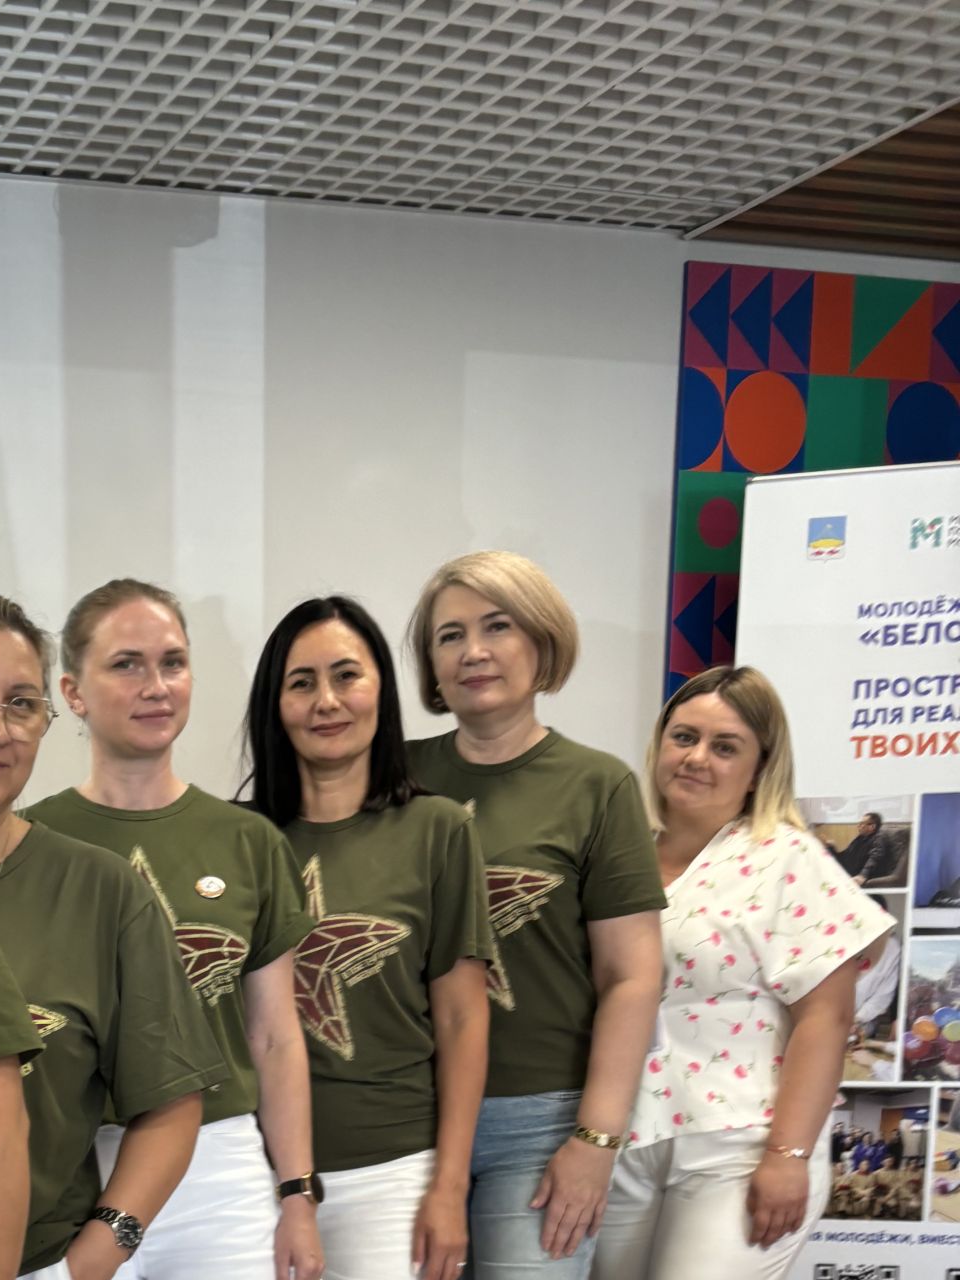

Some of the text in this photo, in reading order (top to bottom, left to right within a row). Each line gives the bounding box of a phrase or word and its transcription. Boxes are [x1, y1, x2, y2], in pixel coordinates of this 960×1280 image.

[850, 703, 960, 729] ДЛЯ РЕА
[849, 731, 960, 759] ТВОИХ
